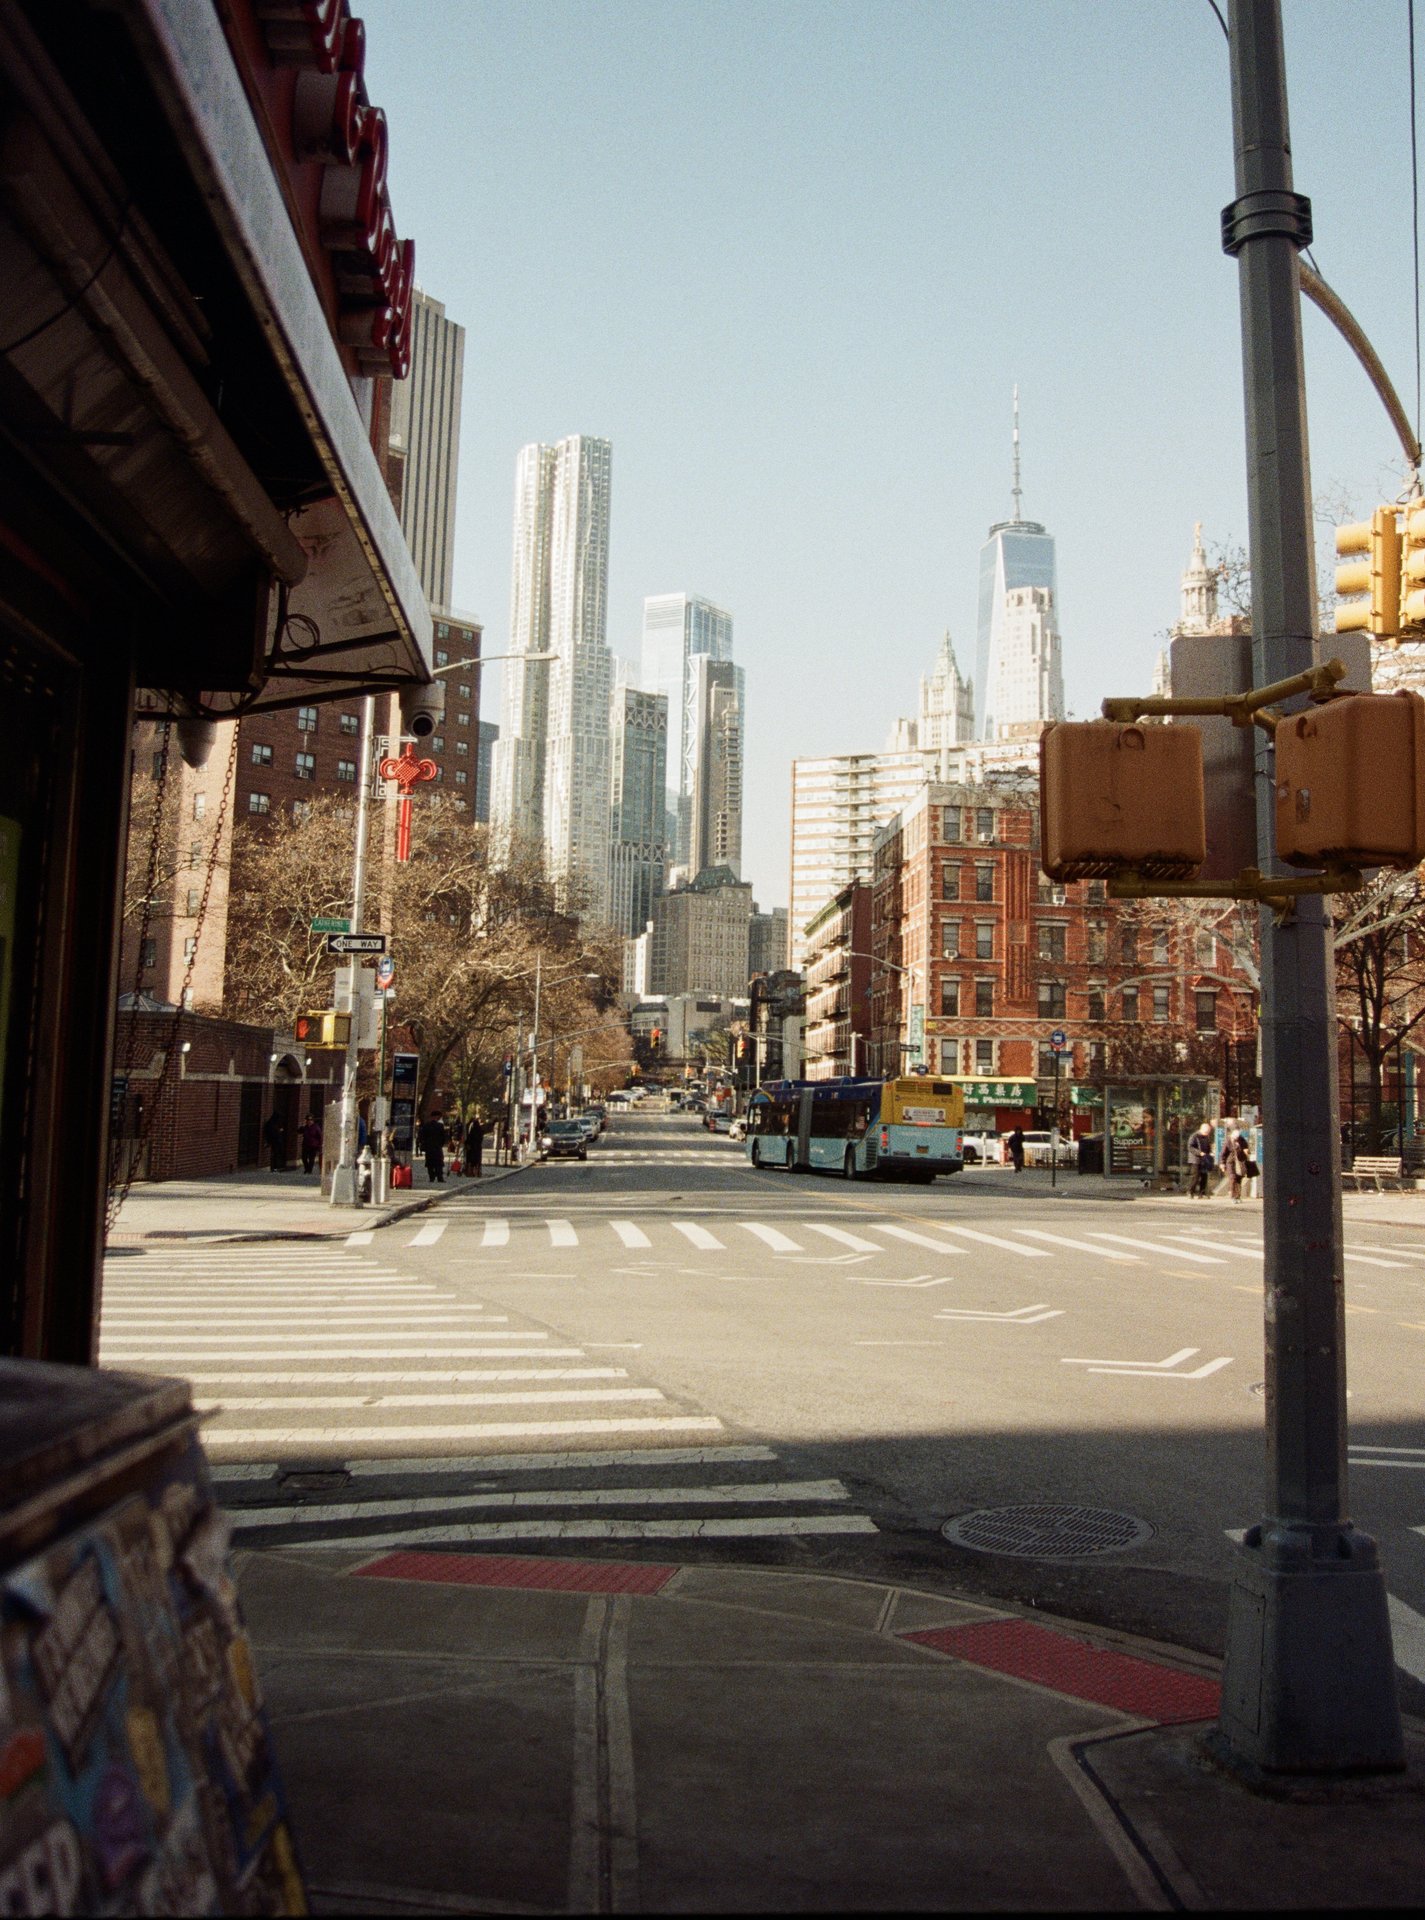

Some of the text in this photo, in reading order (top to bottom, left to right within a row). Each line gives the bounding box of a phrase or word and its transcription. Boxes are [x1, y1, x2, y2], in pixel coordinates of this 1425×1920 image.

[336, 940, 378, 948] ONE WAY
[983, 1096, 1024, 1106] Pharmacy
[1113, 1137, 1144, 1147] Support
